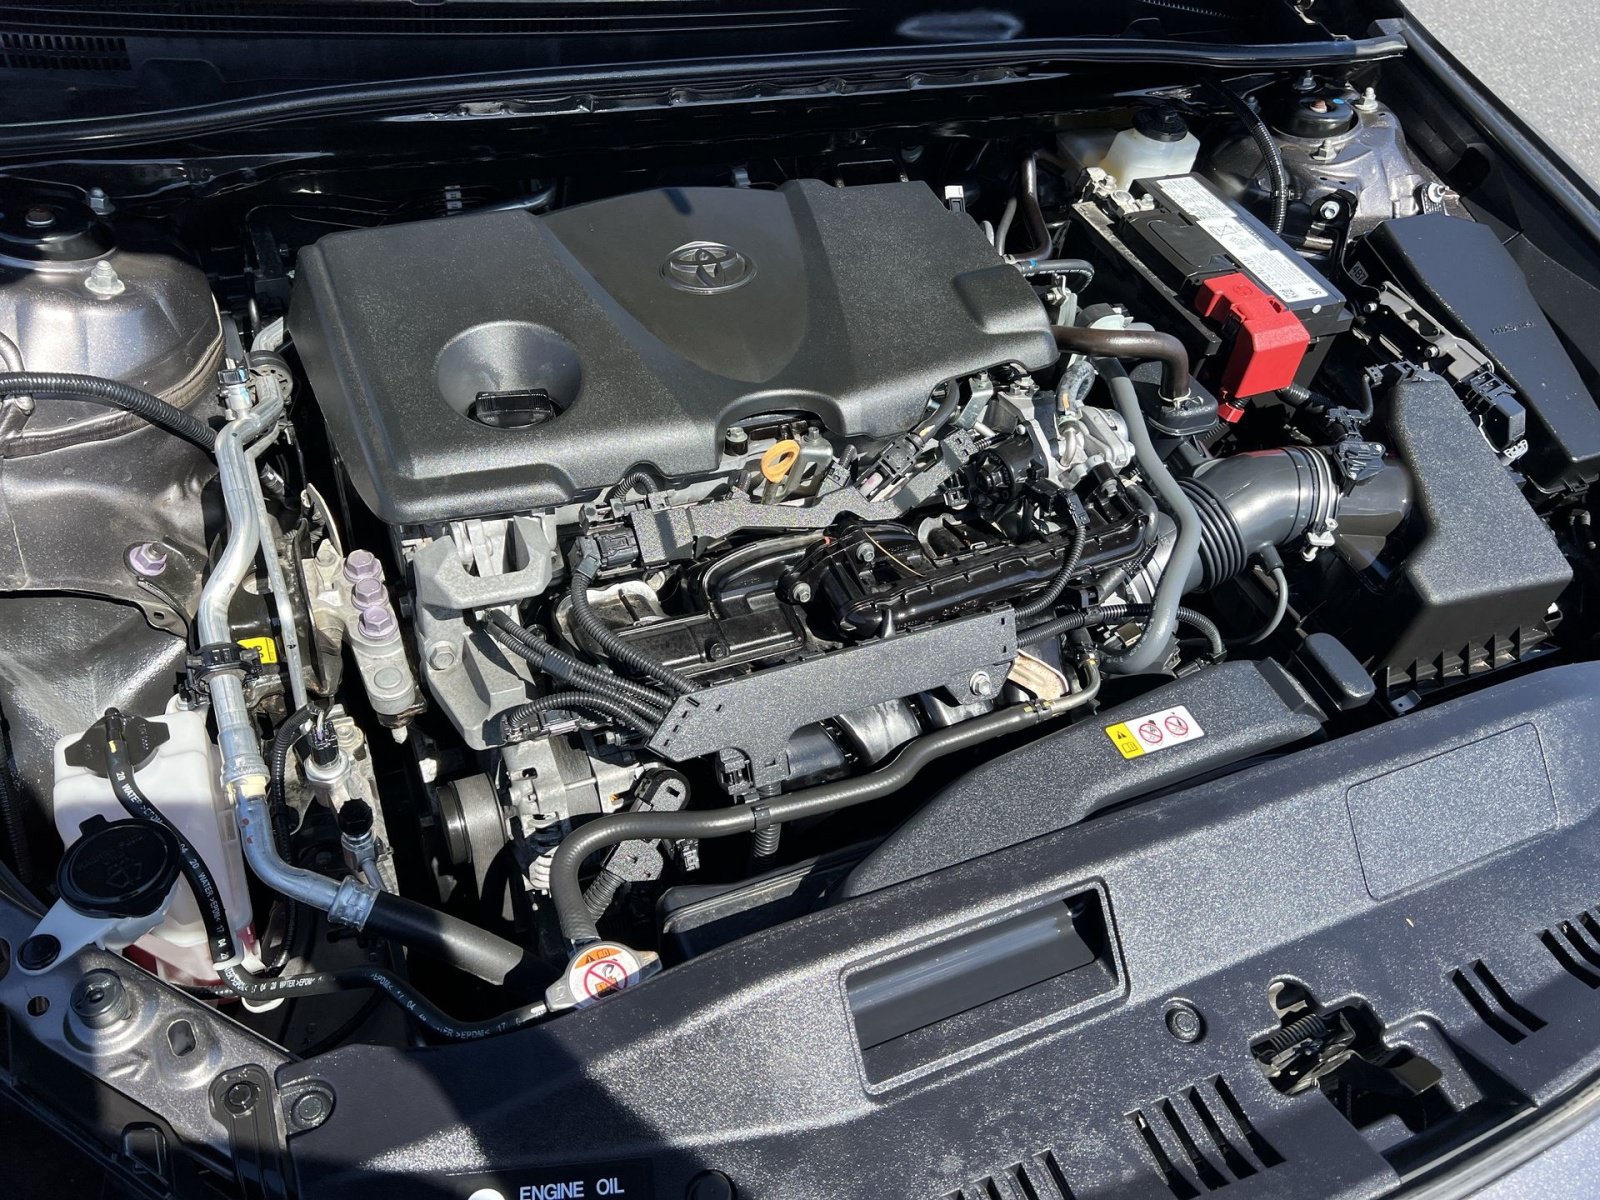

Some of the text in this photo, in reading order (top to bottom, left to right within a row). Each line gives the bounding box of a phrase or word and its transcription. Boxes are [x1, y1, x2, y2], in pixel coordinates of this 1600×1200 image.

[115, 771, 126, 781] 20
[189, 858, 200, 870] 20
[198, 871, 214, 898] WATER
[519, 1177, 625, 1200] ENGINE OIL
